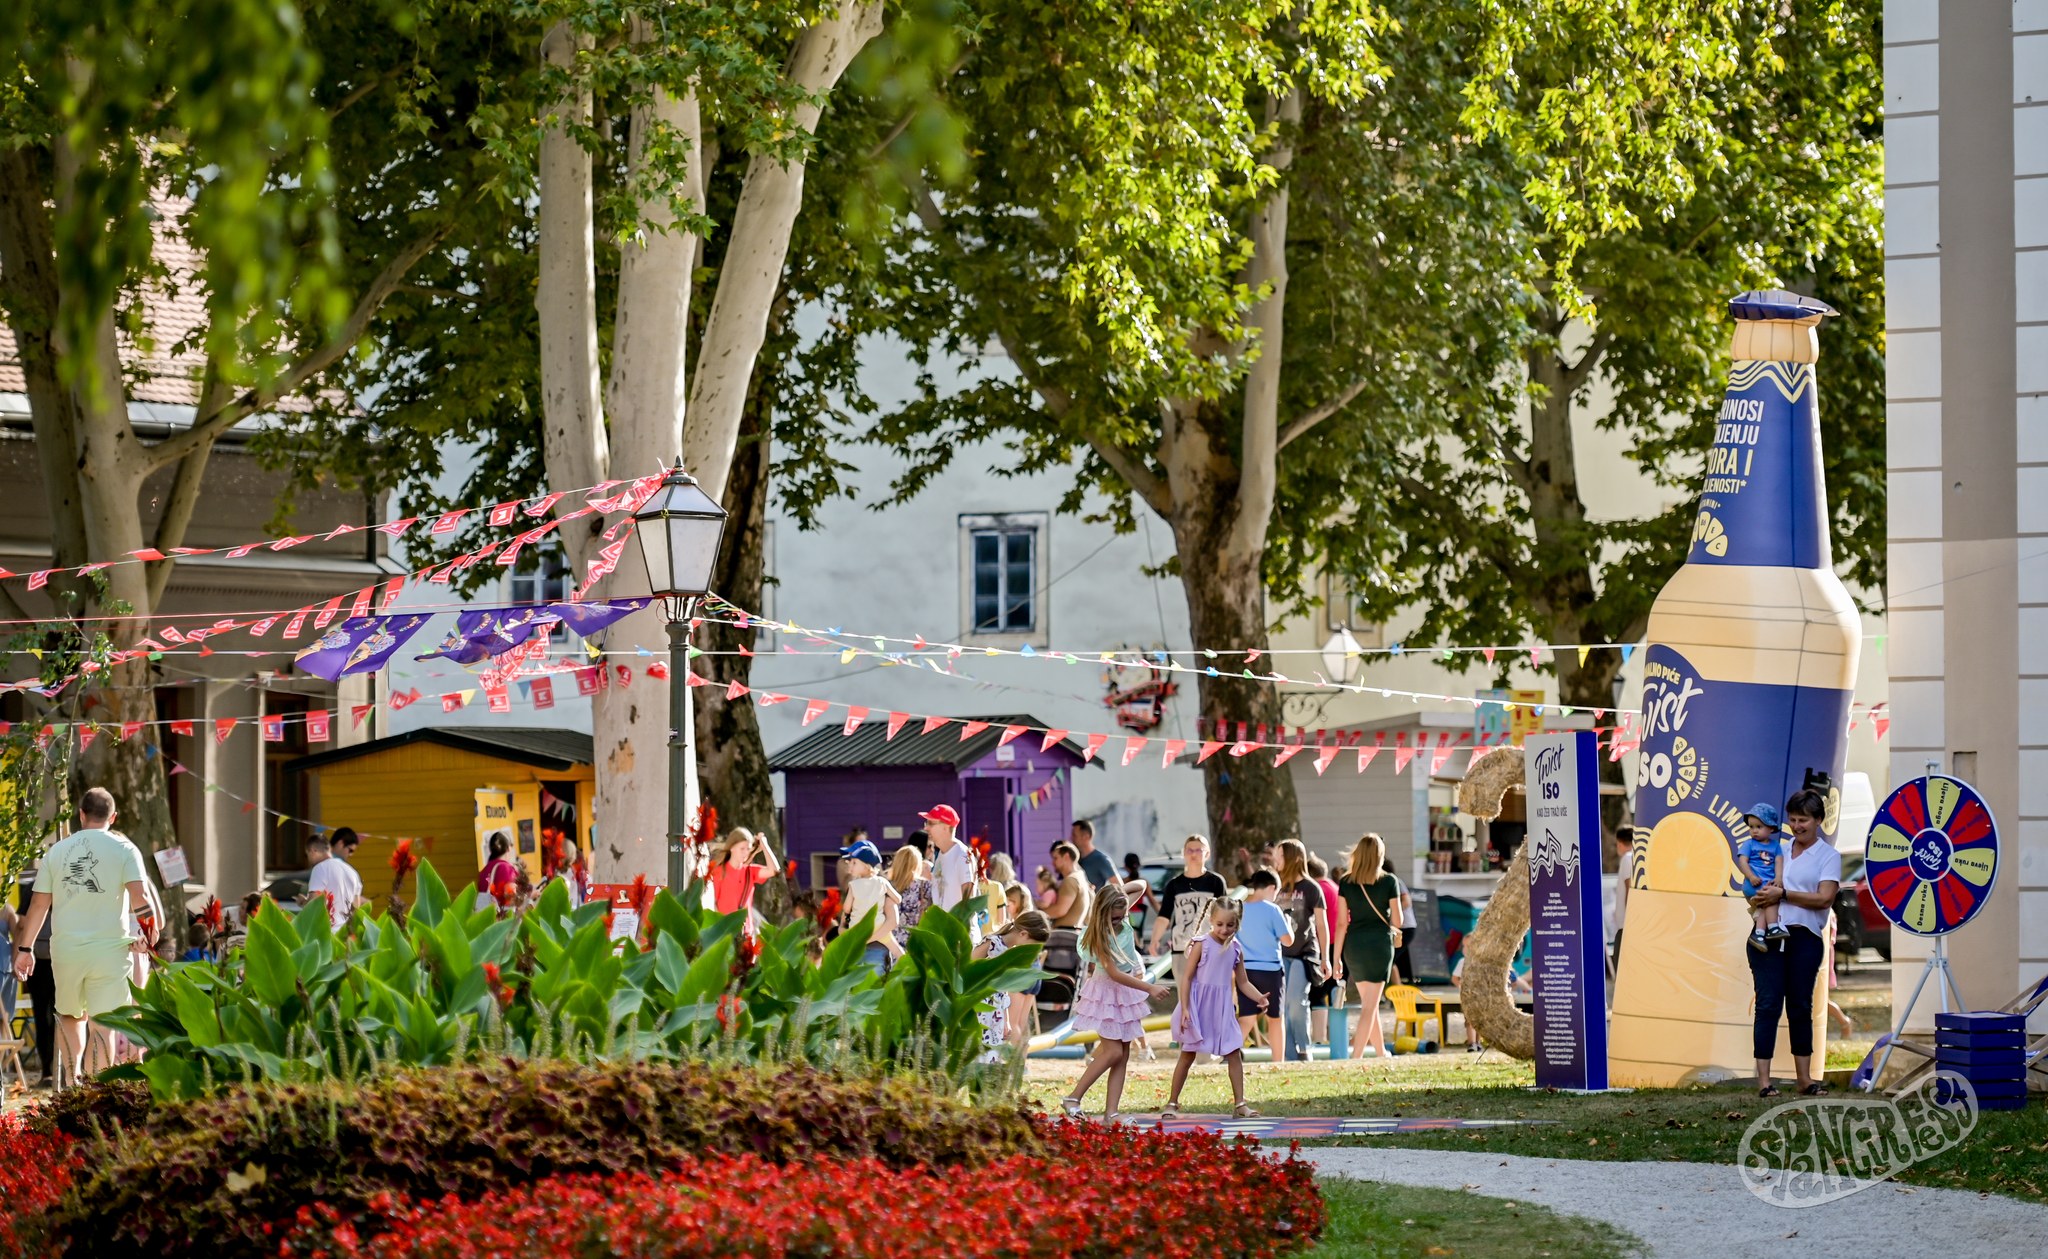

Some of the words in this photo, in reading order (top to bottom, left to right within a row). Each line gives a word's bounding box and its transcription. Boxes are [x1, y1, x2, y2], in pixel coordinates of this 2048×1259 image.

[1744, 448, 1754, 477] I
[1675, 741, 1684, 751] B3
[1535, 743, 1565, 786] Twist
[1683, 753, 1693, 762] B5
[1684, 769, 1693, 777] B6
[1542, 782, 1560, 799] ISO
[1936, 808, 1944, 825] noga
[1873, 841, 1892, 851] Desna
[1893, 844, 1909, 853] noga
[1954, 857, 1970, 866] ruka
[1917, 905, 1925, 926] Desna
